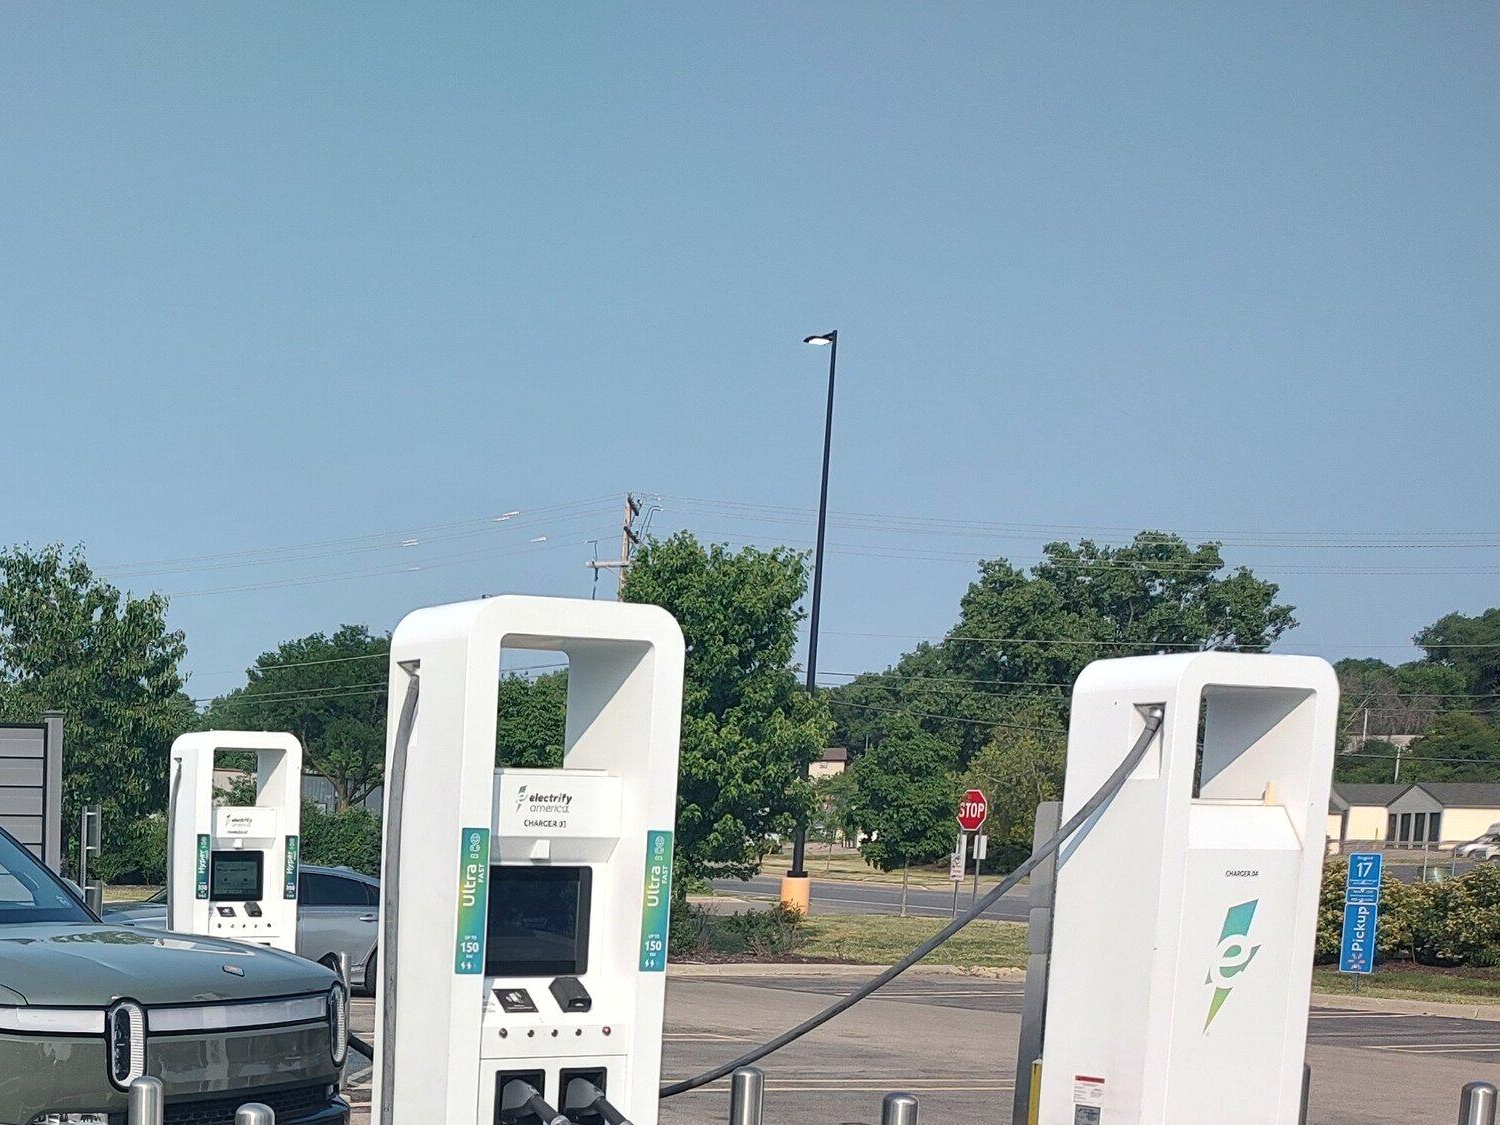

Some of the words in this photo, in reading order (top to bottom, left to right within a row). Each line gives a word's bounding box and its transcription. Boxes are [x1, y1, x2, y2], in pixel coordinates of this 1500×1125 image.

[529, 792, 572, 805] electrify
[959, 801, 985, 819] STOP
[523, 819, 557, 828] CHARGER
[477, 863, 485, 883] FAST
[661, 865, 669, 884] FAST
[1356, 862, 1373, 878] 17
[462, 864, 477, 907] Ultra
[647, 865, 661, 907] Ultra
[1351, 906, 1370, 952] Pickup
[460, 942, 479, 953] 150
[644, 940, 662, 951] 150
